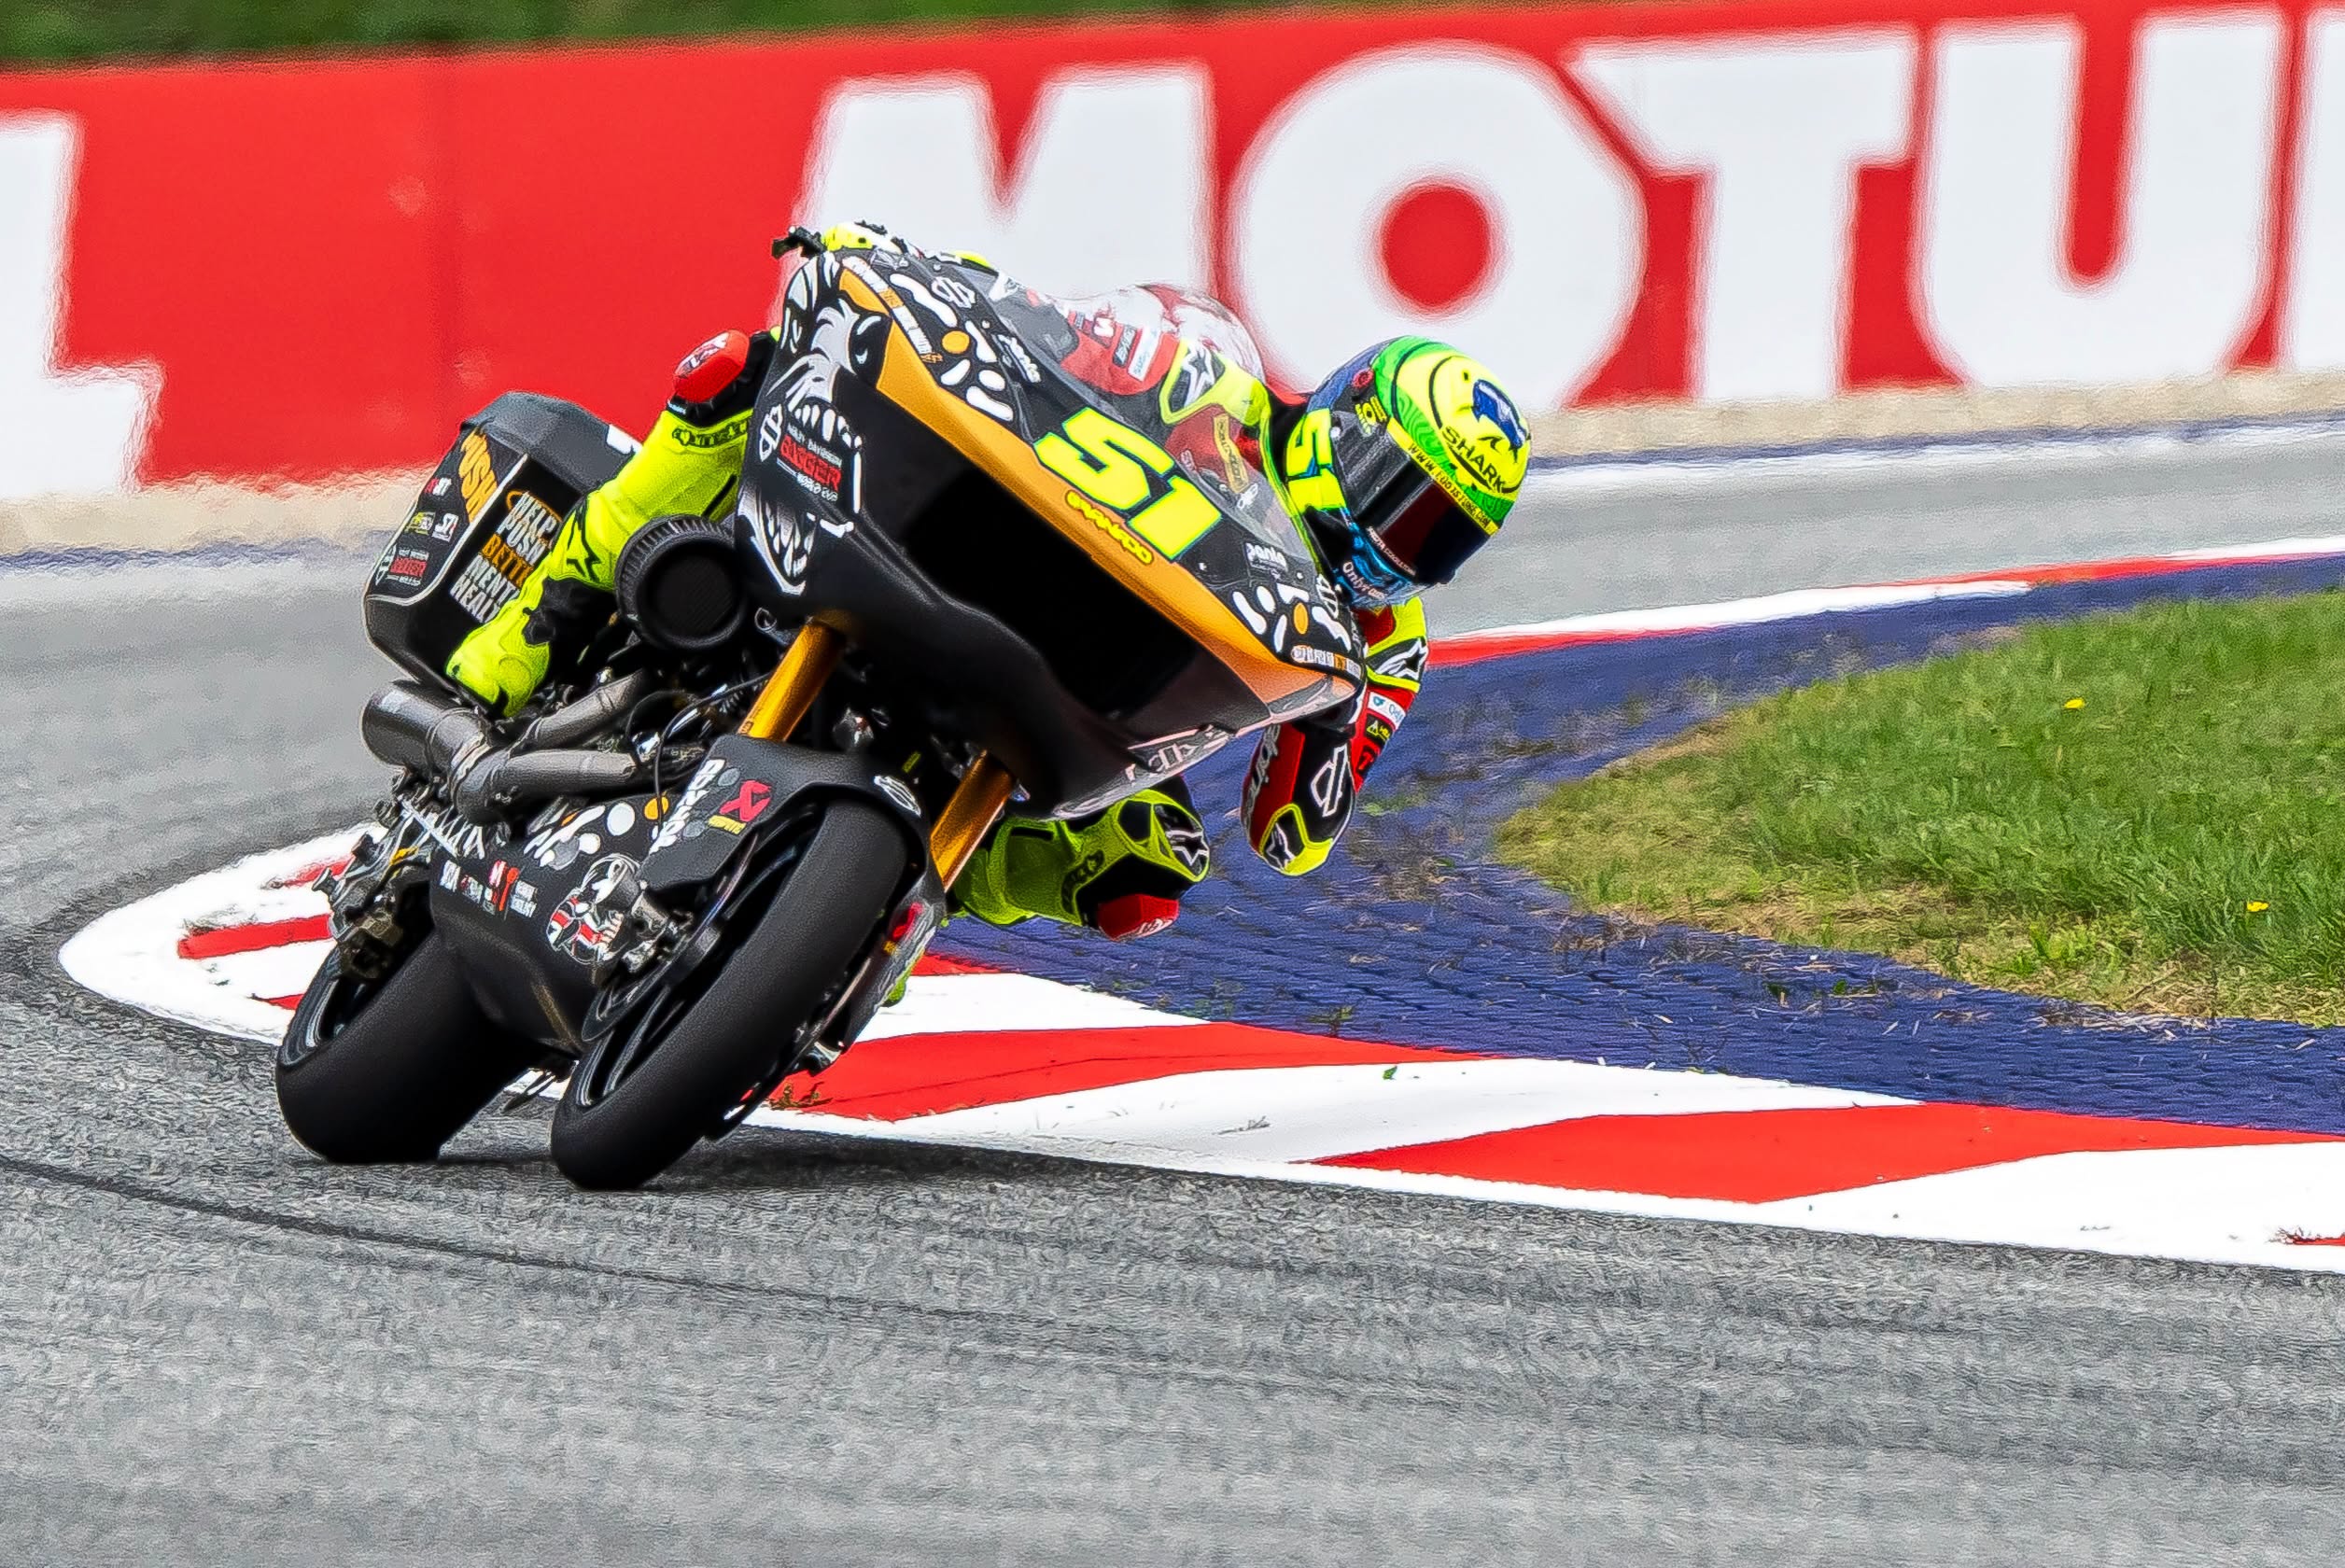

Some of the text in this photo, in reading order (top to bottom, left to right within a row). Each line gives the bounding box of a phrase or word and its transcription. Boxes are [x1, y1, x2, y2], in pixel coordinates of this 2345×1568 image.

[792, 5, 2345, 413] MOTU
[1033, 407, 1222, 560] 51
[1441, 426, 1507, 493] SHARK
[465, 553, 523, 603] MENT
